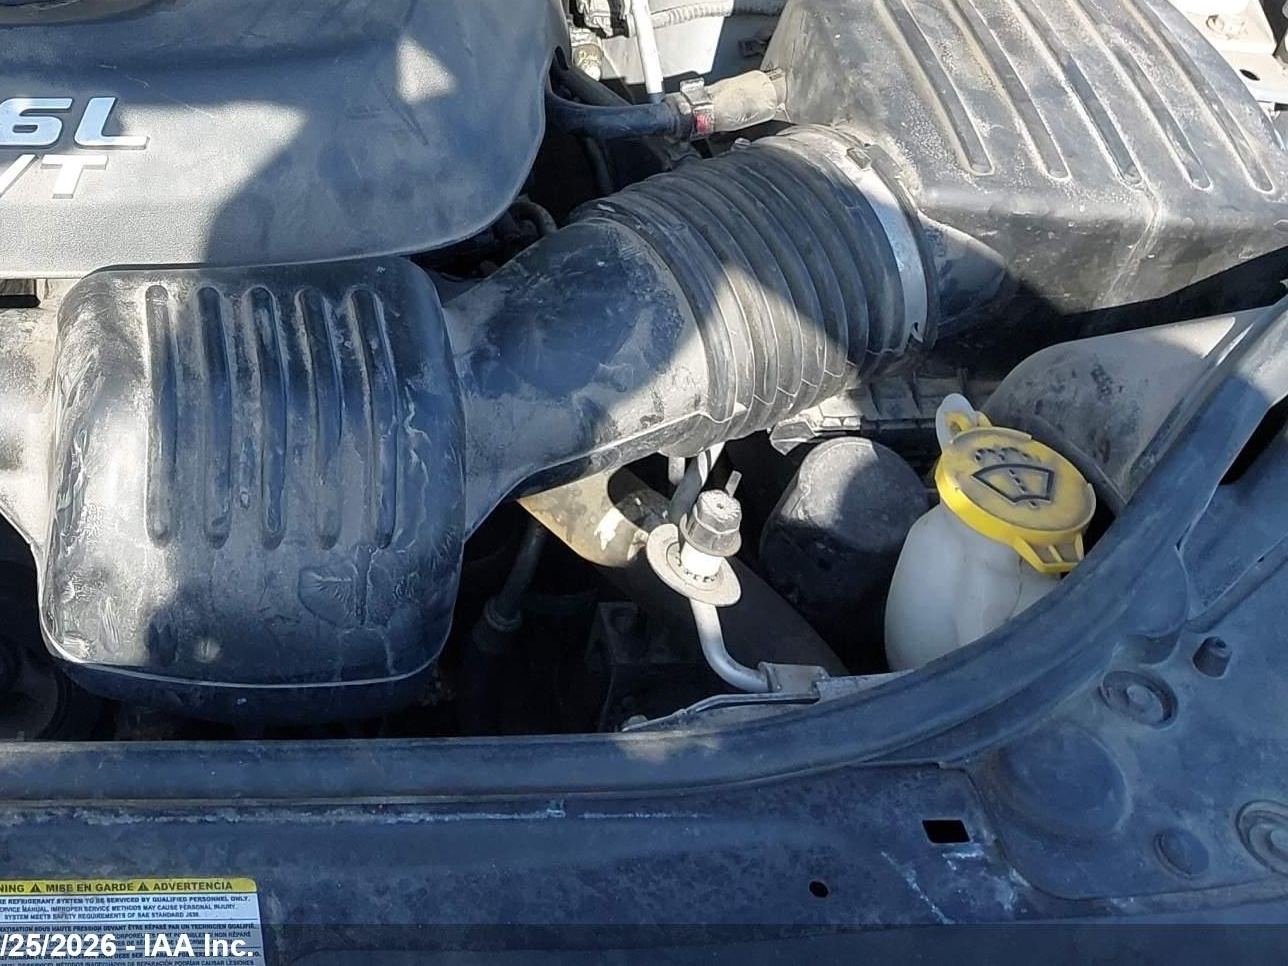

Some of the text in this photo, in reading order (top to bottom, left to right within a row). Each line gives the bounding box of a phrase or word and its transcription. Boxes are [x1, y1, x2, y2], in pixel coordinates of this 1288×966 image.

[46, 884, 73, 892] MISE
[76, 884, 93, 892] EN
[95, 882, 134, 891] GARDE
[153, 881, 233, 891] ADVERTENCIA
[72, 924, 102, 932] PRESSION
